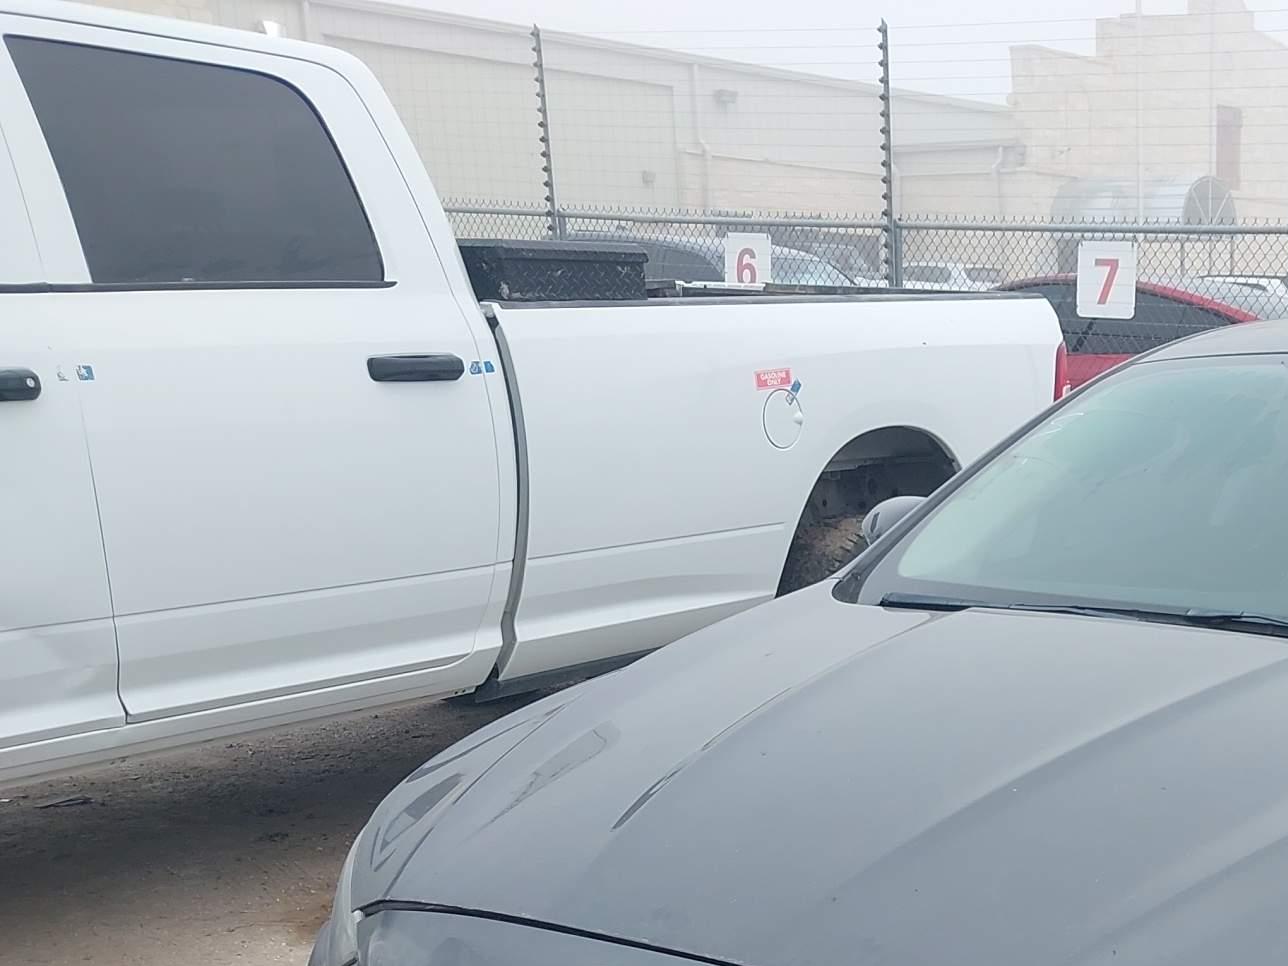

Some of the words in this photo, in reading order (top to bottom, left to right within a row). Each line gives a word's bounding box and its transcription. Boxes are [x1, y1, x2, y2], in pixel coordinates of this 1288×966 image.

[736, 247, 757, 283] 6
[1095, 258, 1119, 305] 7
[766, 378, 781, 386] ONLY
